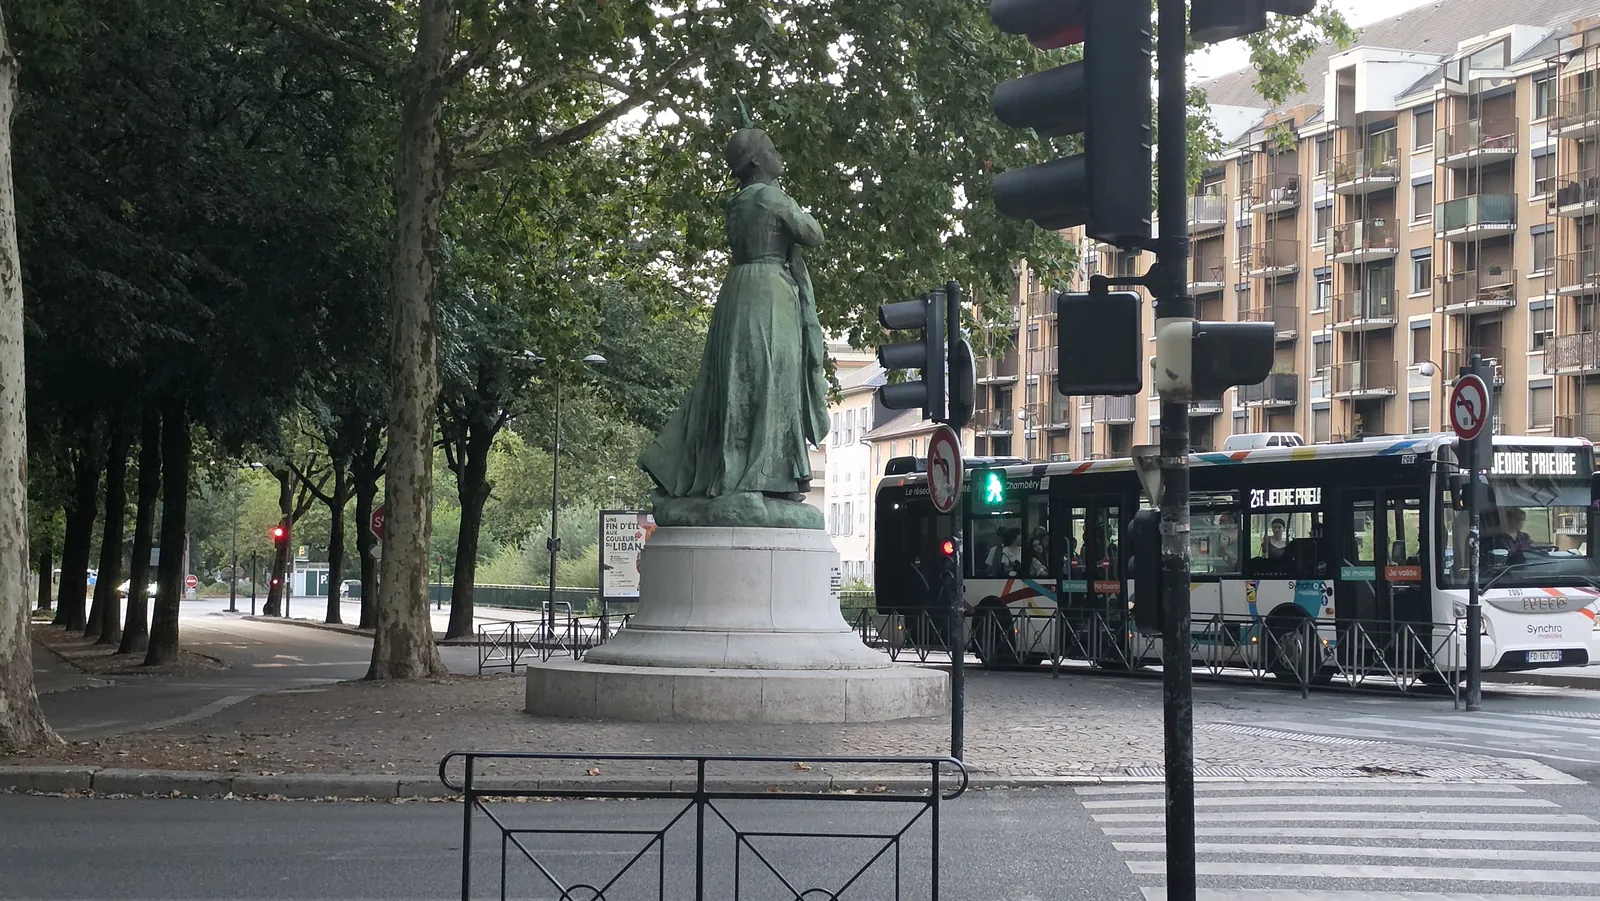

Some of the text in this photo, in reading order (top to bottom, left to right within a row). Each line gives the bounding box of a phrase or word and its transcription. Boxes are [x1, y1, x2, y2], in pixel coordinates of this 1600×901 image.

[1491, 452, 1577, 475] JEOIRE PRIEURE
[620, 521, 640, 530] D'ÉTÉ
[1526, 624, 1563, 635] Synchro
